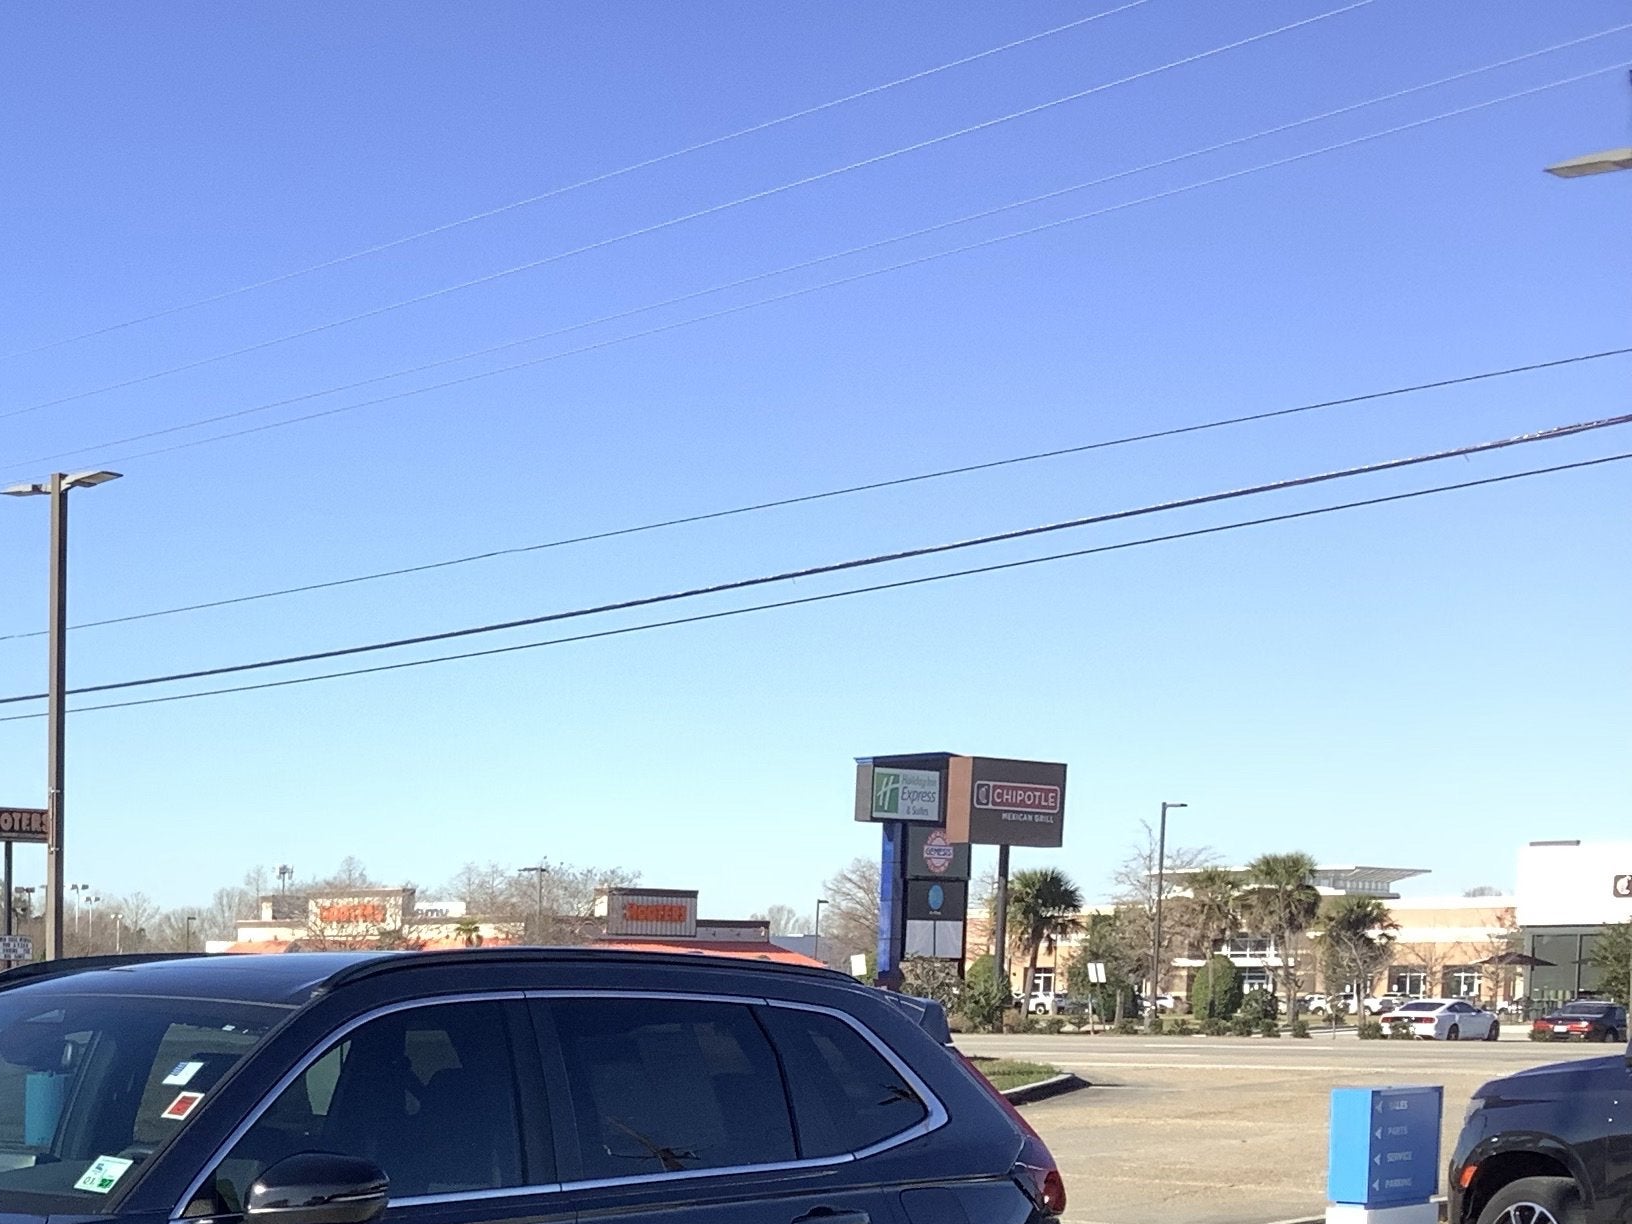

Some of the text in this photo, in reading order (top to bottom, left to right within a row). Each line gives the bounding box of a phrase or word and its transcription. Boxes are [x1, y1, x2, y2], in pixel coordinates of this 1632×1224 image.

[901, 786, 937, 804] Express
[993, 788, 1057, 807] CHIPOTLE
[1001, 813, 1054, 824] MEXICAN GRILL
